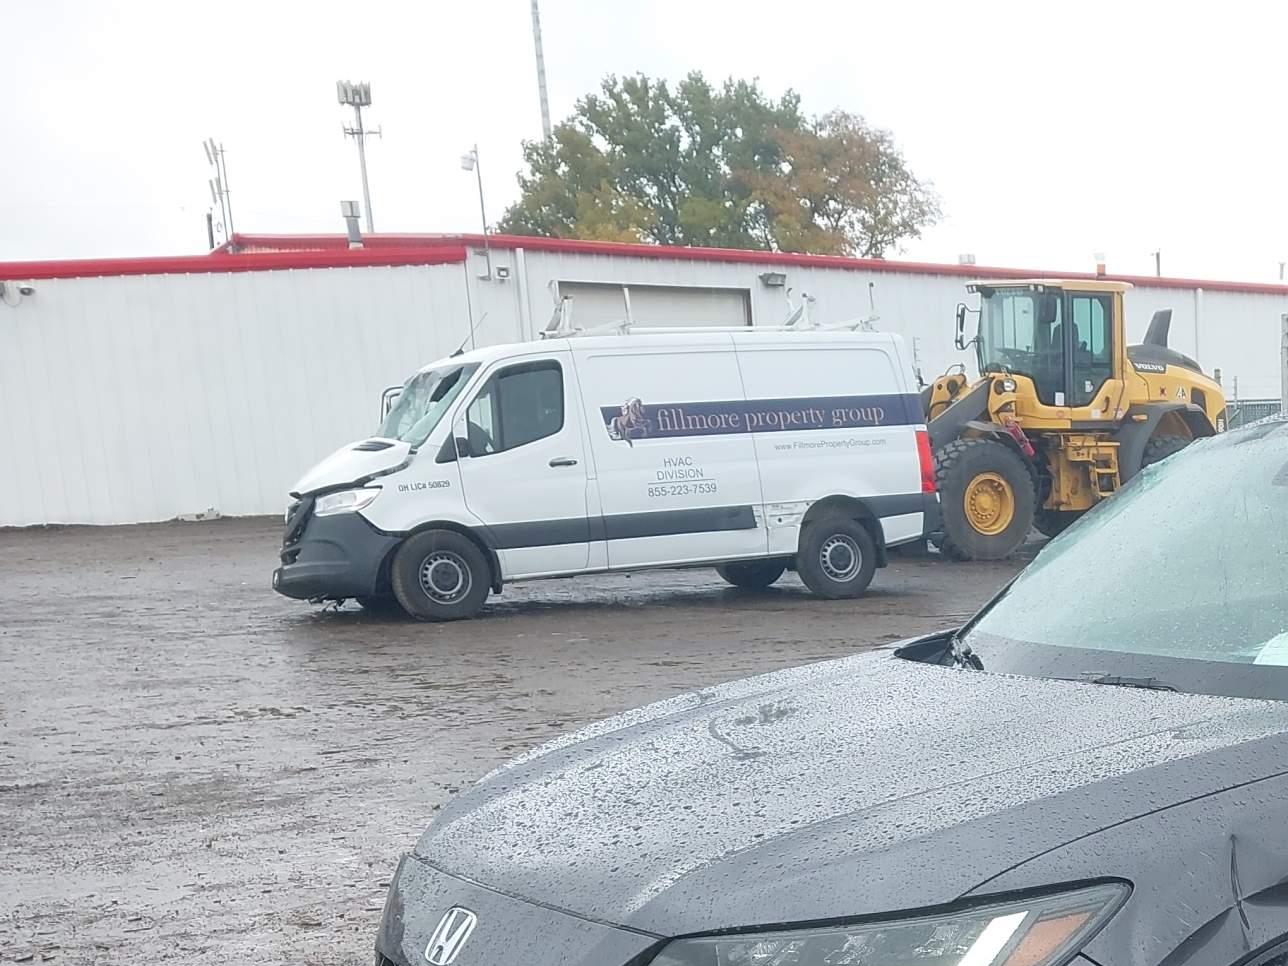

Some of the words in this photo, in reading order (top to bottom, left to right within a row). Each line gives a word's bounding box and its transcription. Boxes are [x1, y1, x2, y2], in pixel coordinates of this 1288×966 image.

[1134, 362, 1165, 371] VOLVO
[657, 408, 740, 431] fillmore
[744, 407, 825, 431] property
[831, 406, 884, 426] group
[663, 456, 693, 467] HVAC
[656, 468, 704, 480] DIVISION
[647, 482, 717, 497] 855-223-7539
